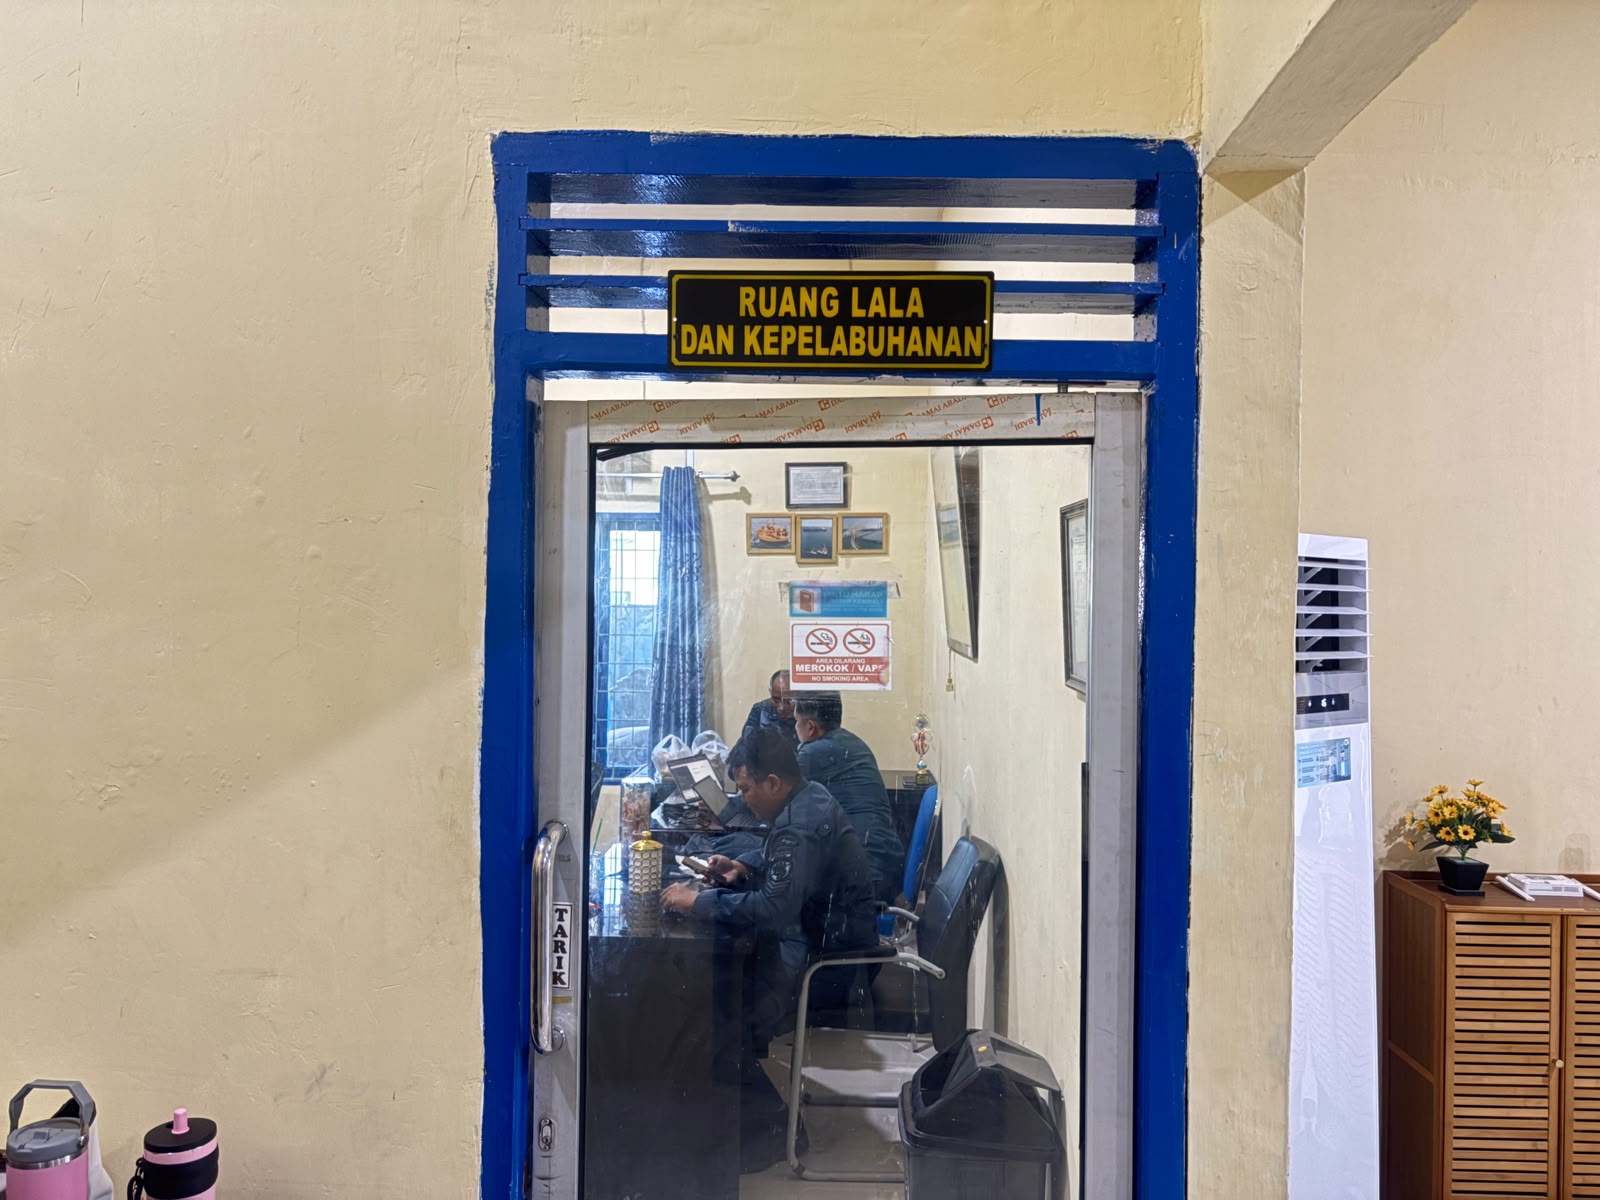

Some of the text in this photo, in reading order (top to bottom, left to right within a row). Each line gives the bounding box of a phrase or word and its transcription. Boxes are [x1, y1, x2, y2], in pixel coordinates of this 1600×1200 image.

[739, 286, 924, 318] RUANG LALA
[681, 324, 982, 357] DAN KEPELABUHANAN
[795, 664, 849, 673] MEROKOK
[552, 908, 569, 986] TARIK
